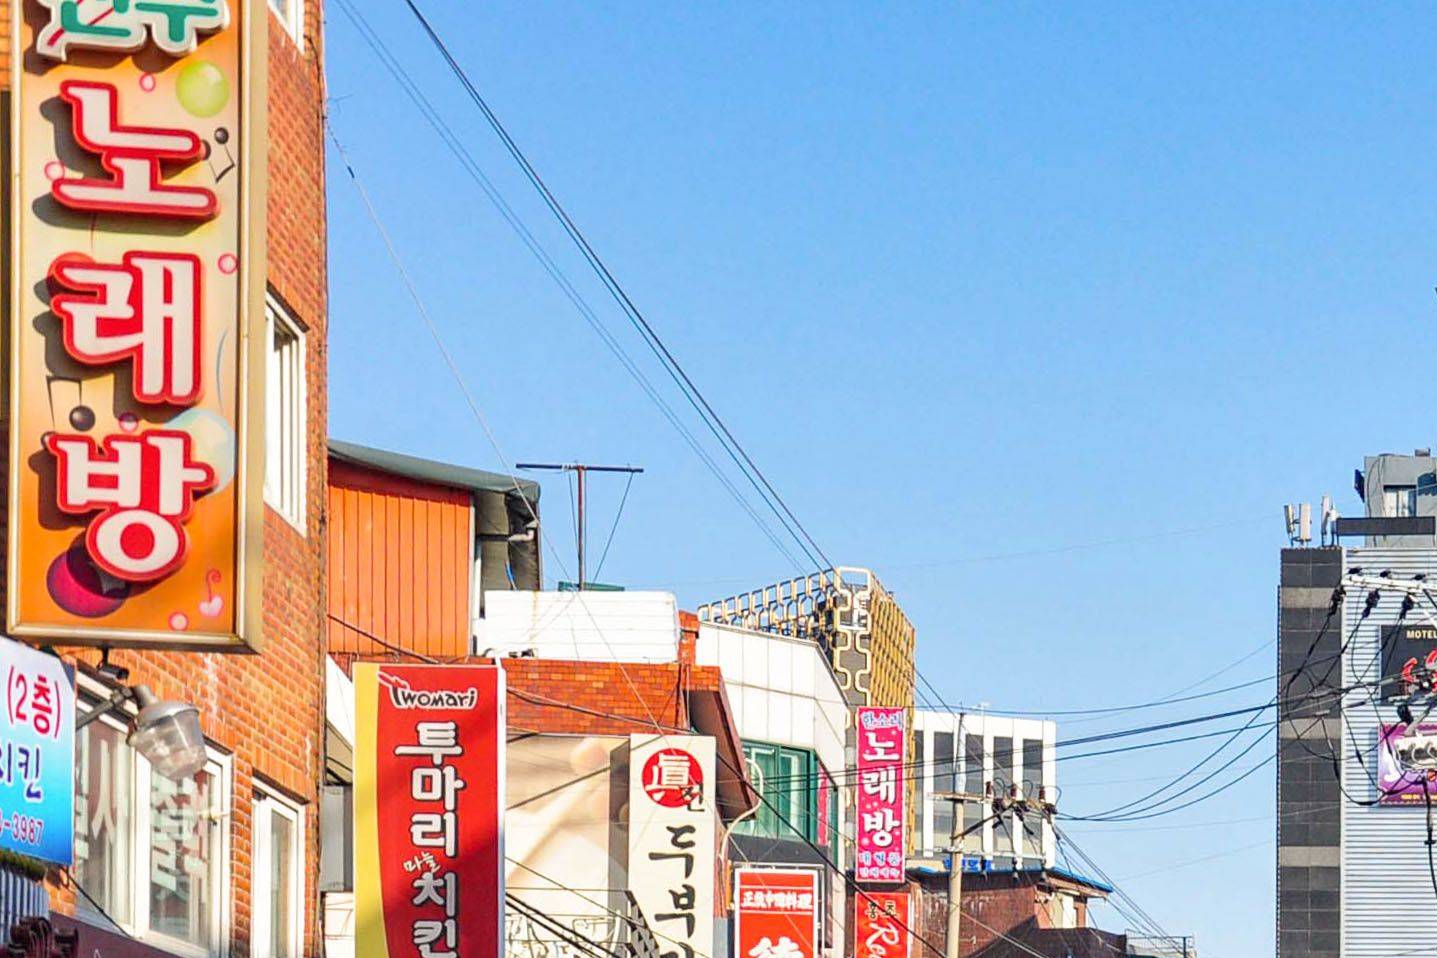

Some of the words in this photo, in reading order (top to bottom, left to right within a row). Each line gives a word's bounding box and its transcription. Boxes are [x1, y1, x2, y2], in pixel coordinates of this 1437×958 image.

[50, 79, 221, 581] 노래방
[7, 665, 62, 739] (2층)
[0, 810, 44, 845] -3987
[394, 720, 467, 858] 투마리
[862, 731, 900, 847] 노래방
[402, 851, 441, 873] 마늘
